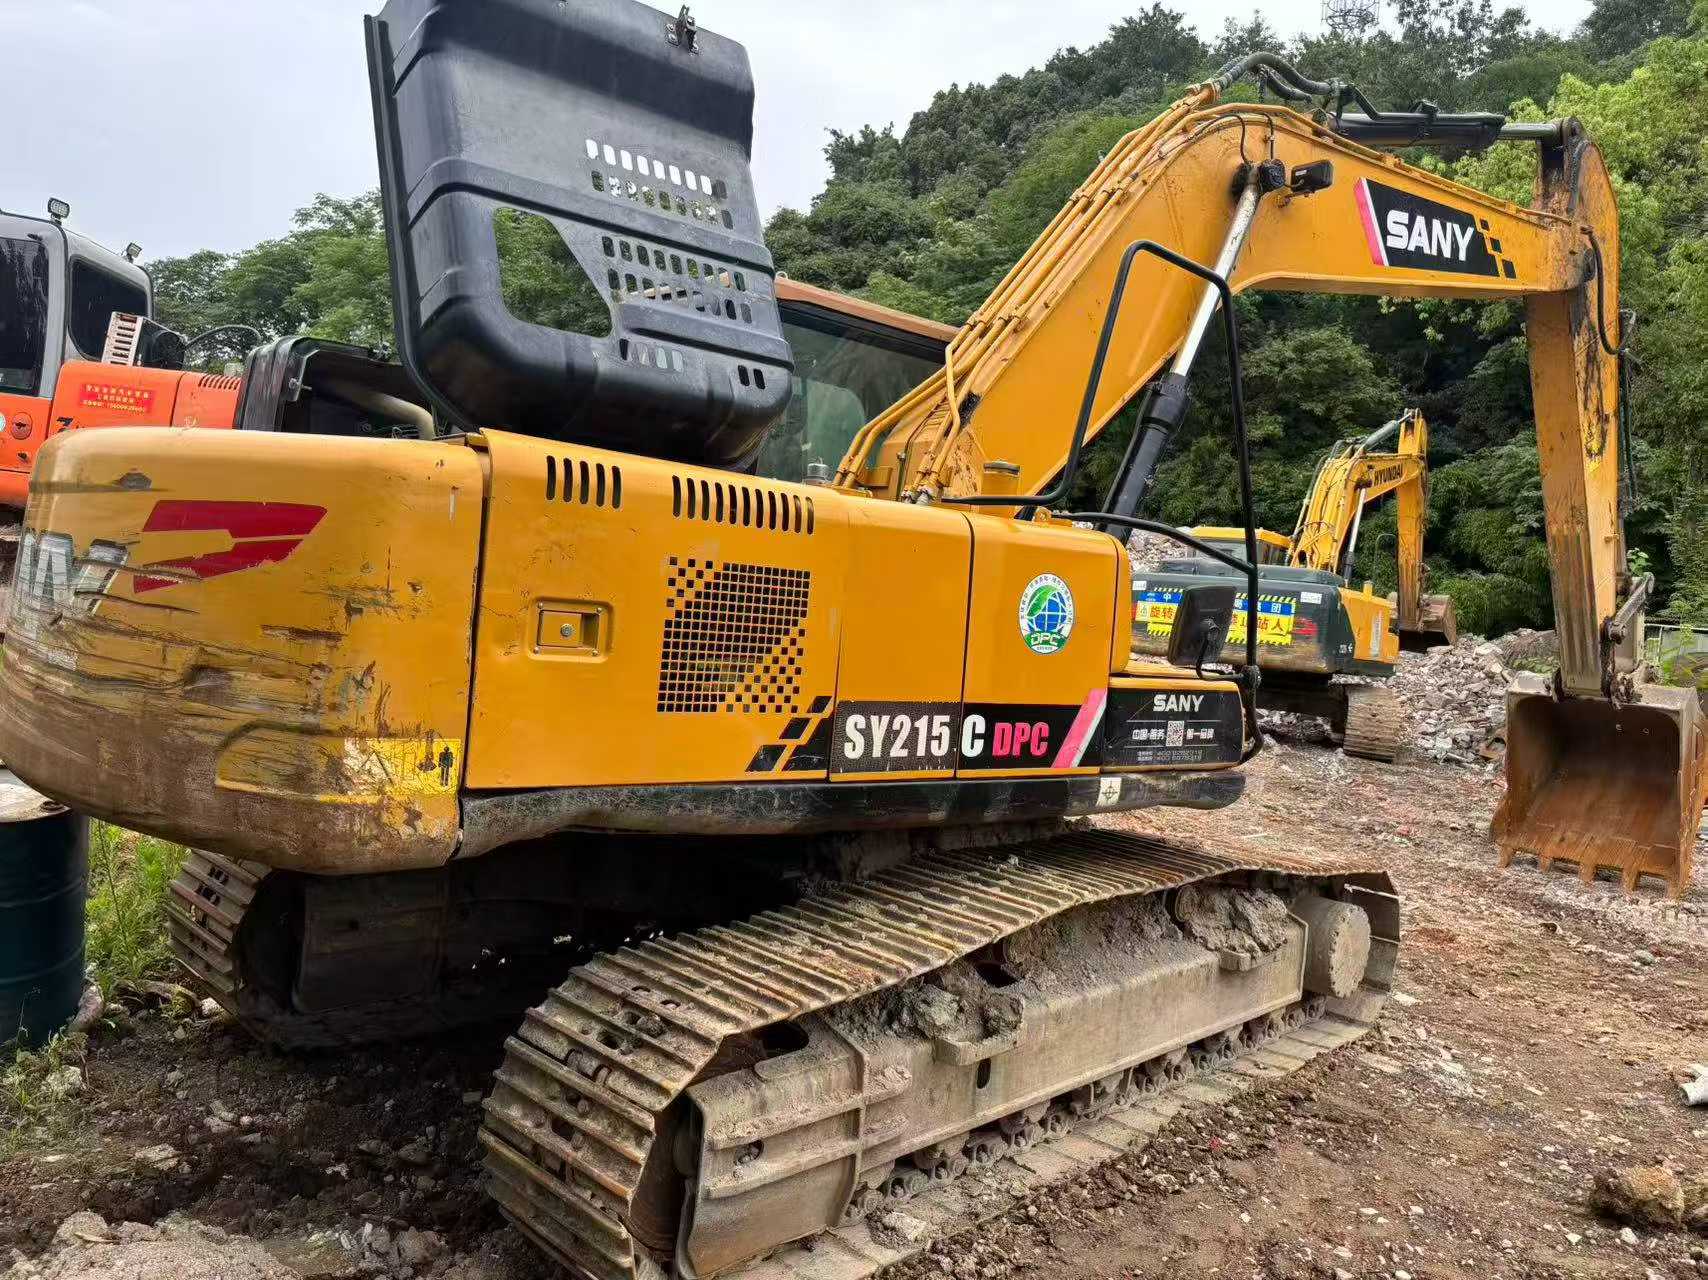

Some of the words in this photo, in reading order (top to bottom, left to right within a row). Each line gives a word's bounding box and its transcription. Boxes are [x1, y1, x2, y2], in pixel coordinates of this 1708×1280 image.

[1386, 209, 1474, 261] SANY
[1153, 694, 1204, 712] SANY
[844, 714, 950, 759] SY215
[962, 714, 985, 758] C
[991, 722, 1049, 757] DPC
